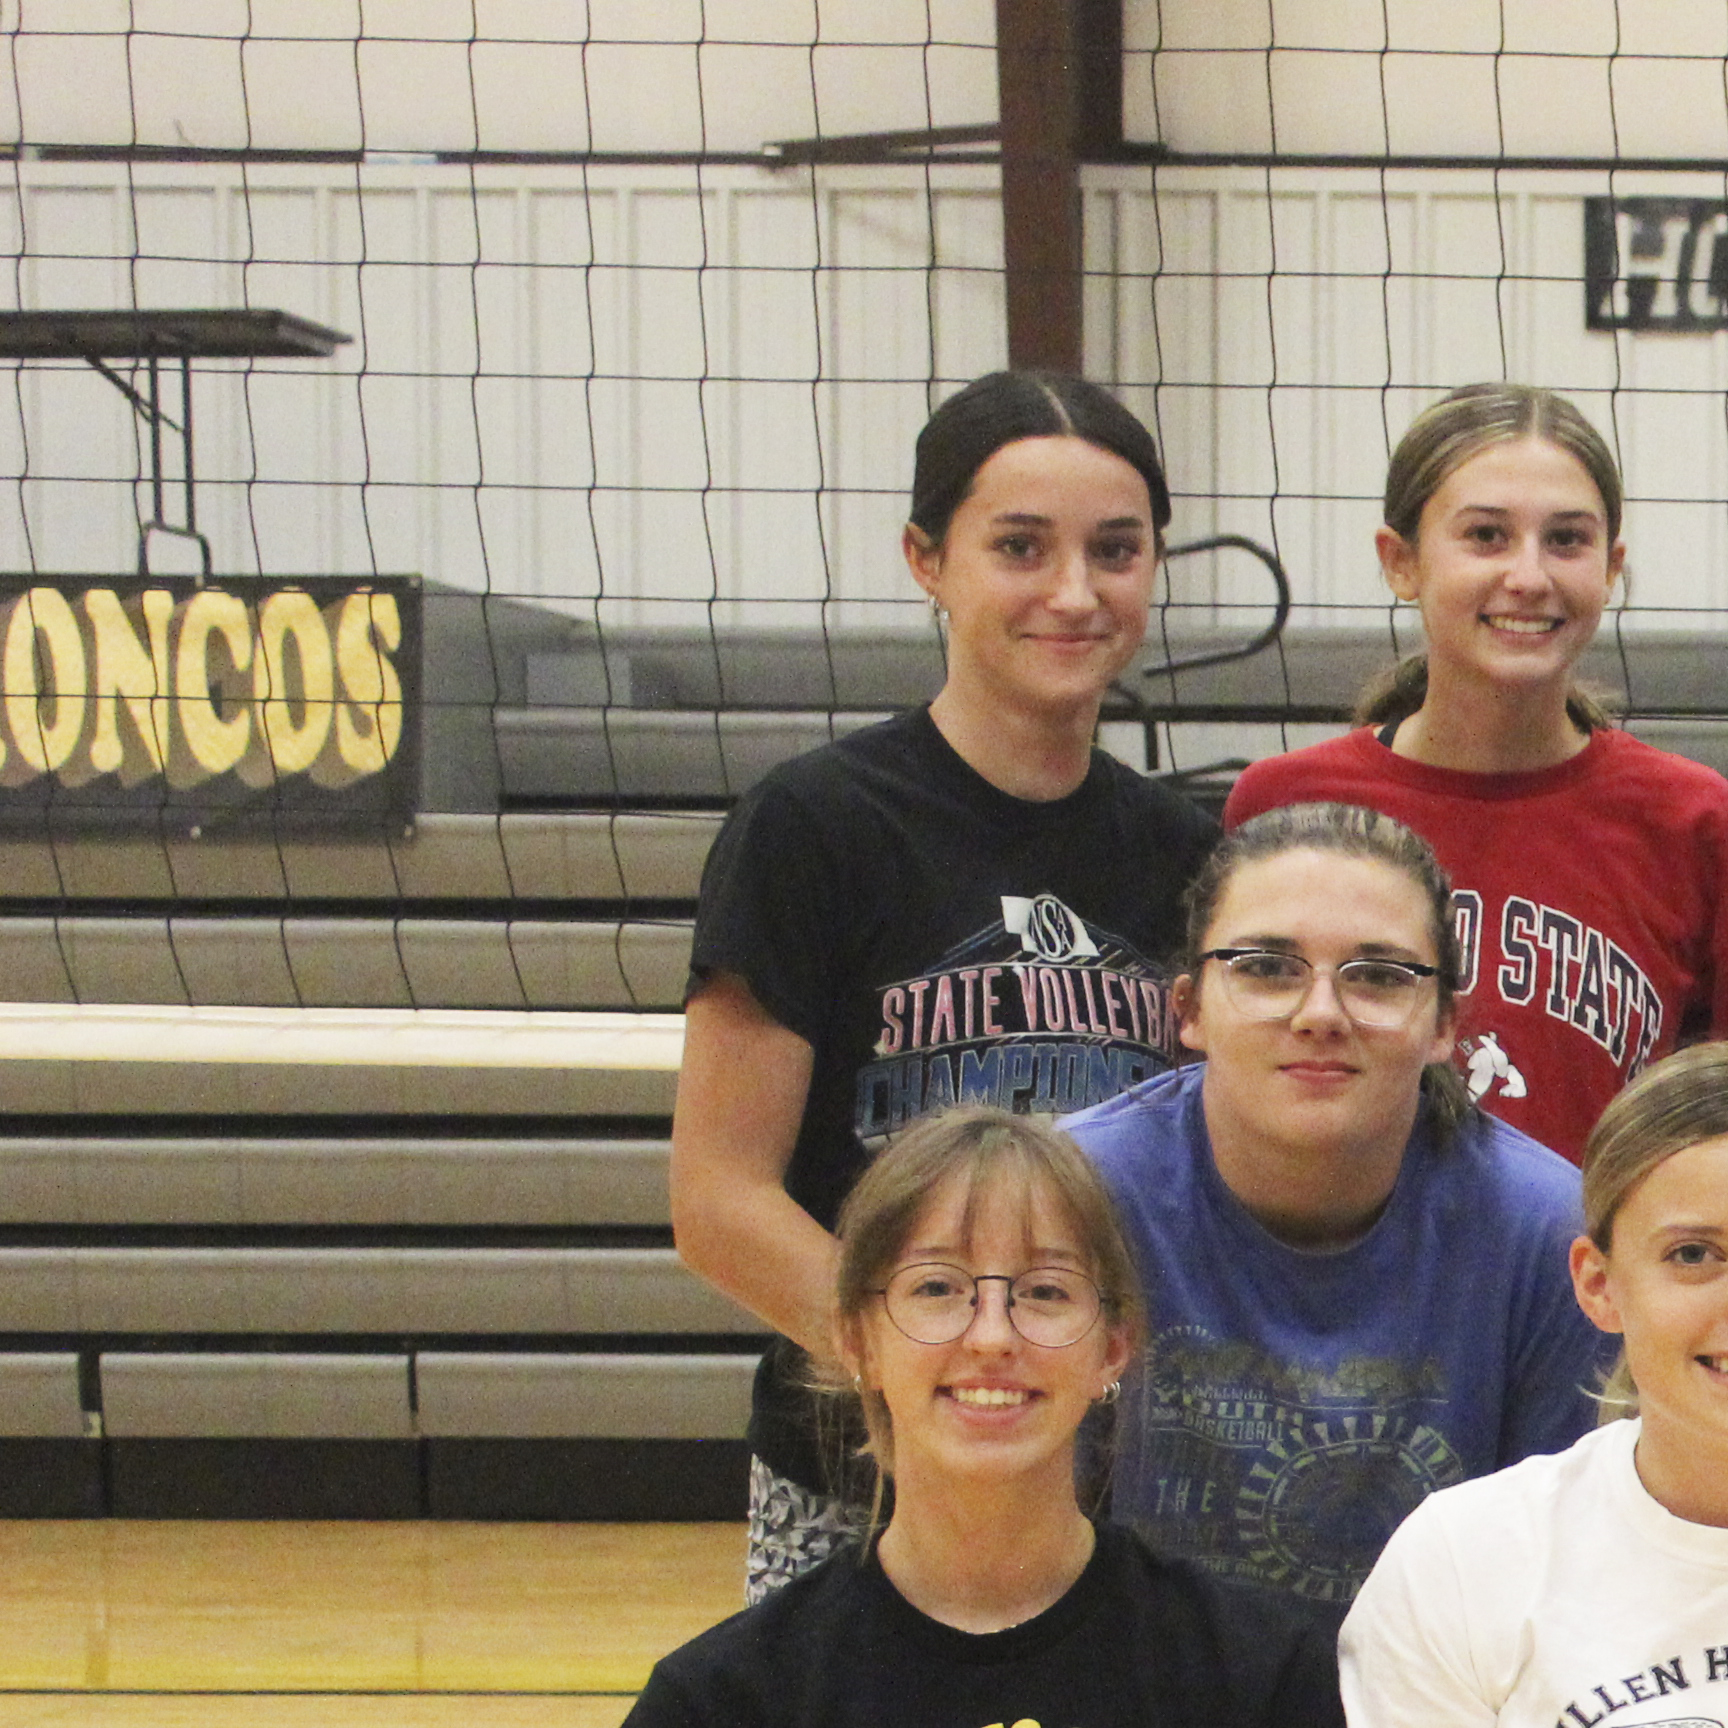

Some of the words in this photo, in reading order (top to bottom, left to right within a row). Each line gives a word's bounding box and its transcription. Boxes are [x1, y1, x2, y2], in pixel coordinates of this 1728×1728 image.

[0, 586, 403, 775] ONCOS
[880, 966, 1004, 1054] STATE
[1498, 894, 1664, 1084] STATE
